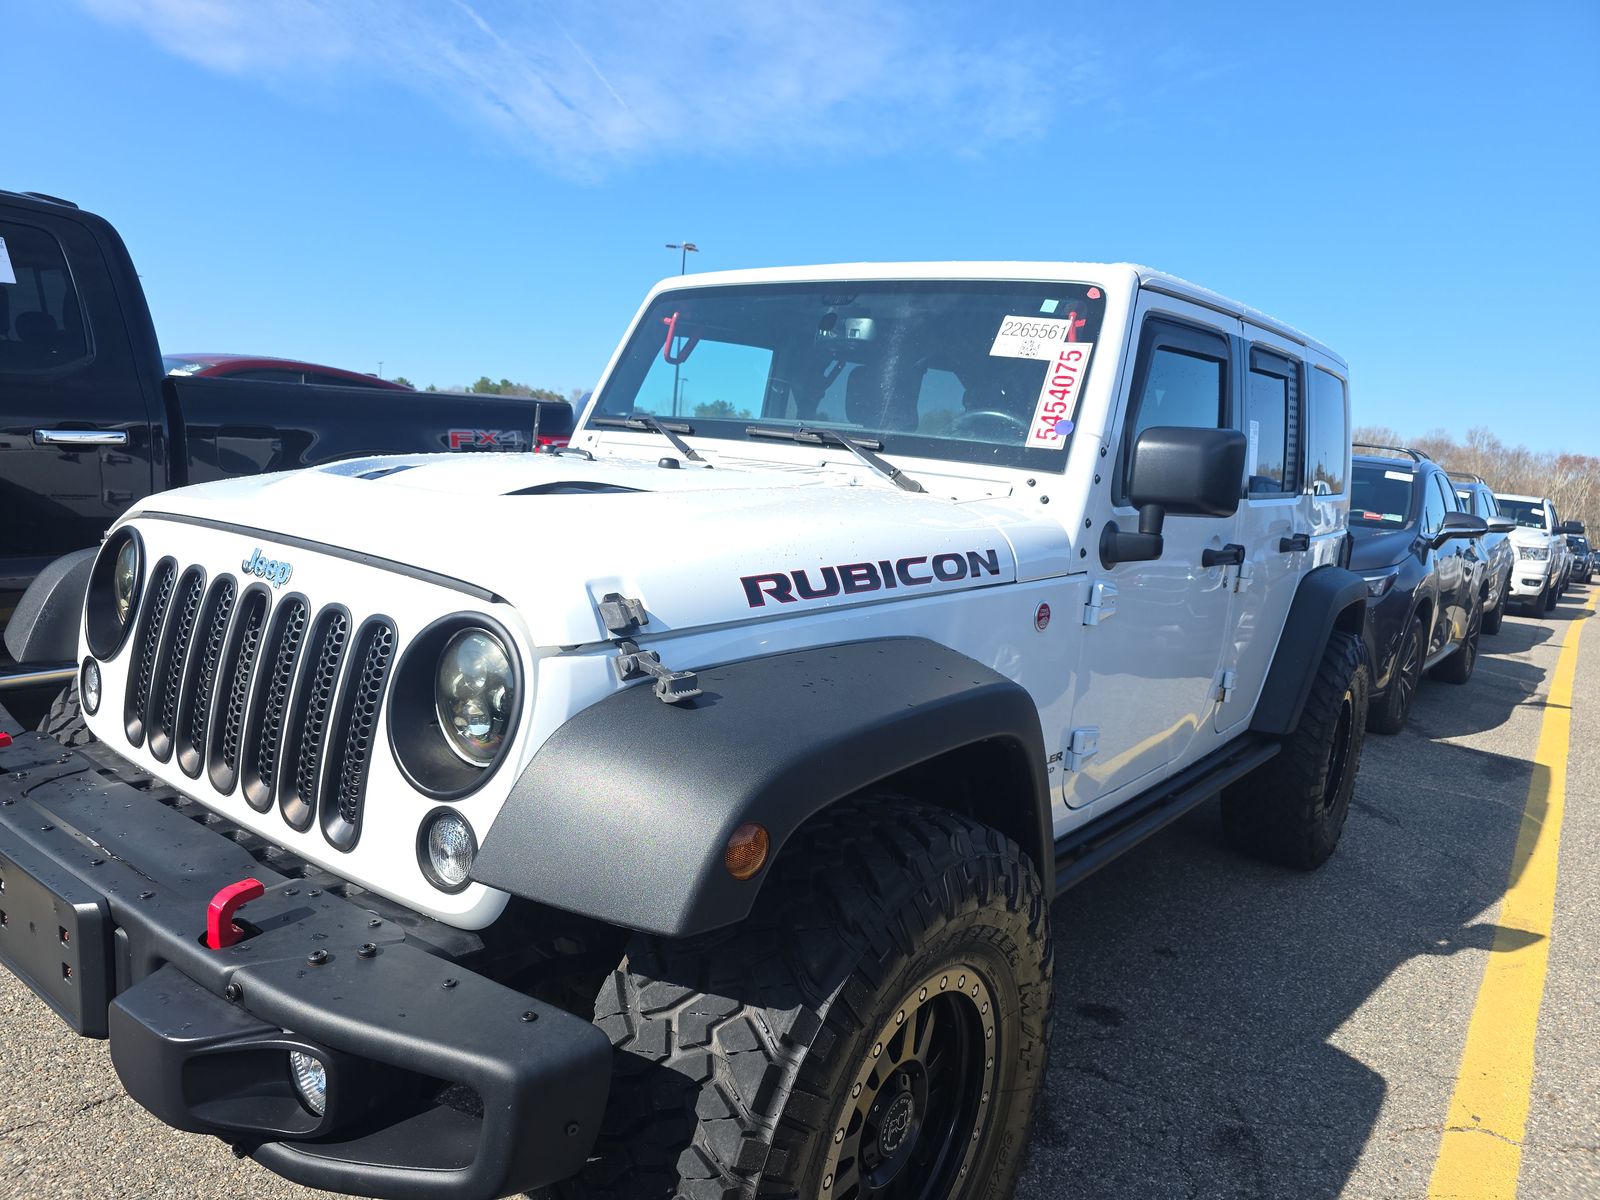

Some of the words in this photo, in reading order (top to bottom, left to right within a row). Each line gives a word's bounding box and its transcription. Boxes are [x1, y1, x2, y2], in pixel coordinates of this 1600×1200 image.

[1001, 321, 1068, 340] 2265561
[1035, 350, 1082, 441] 5454075
[448, 428, 525, 449] FX4
[241, 547, 293, 589] Jeep
[740, 549, 1000, 608] RUBICON
